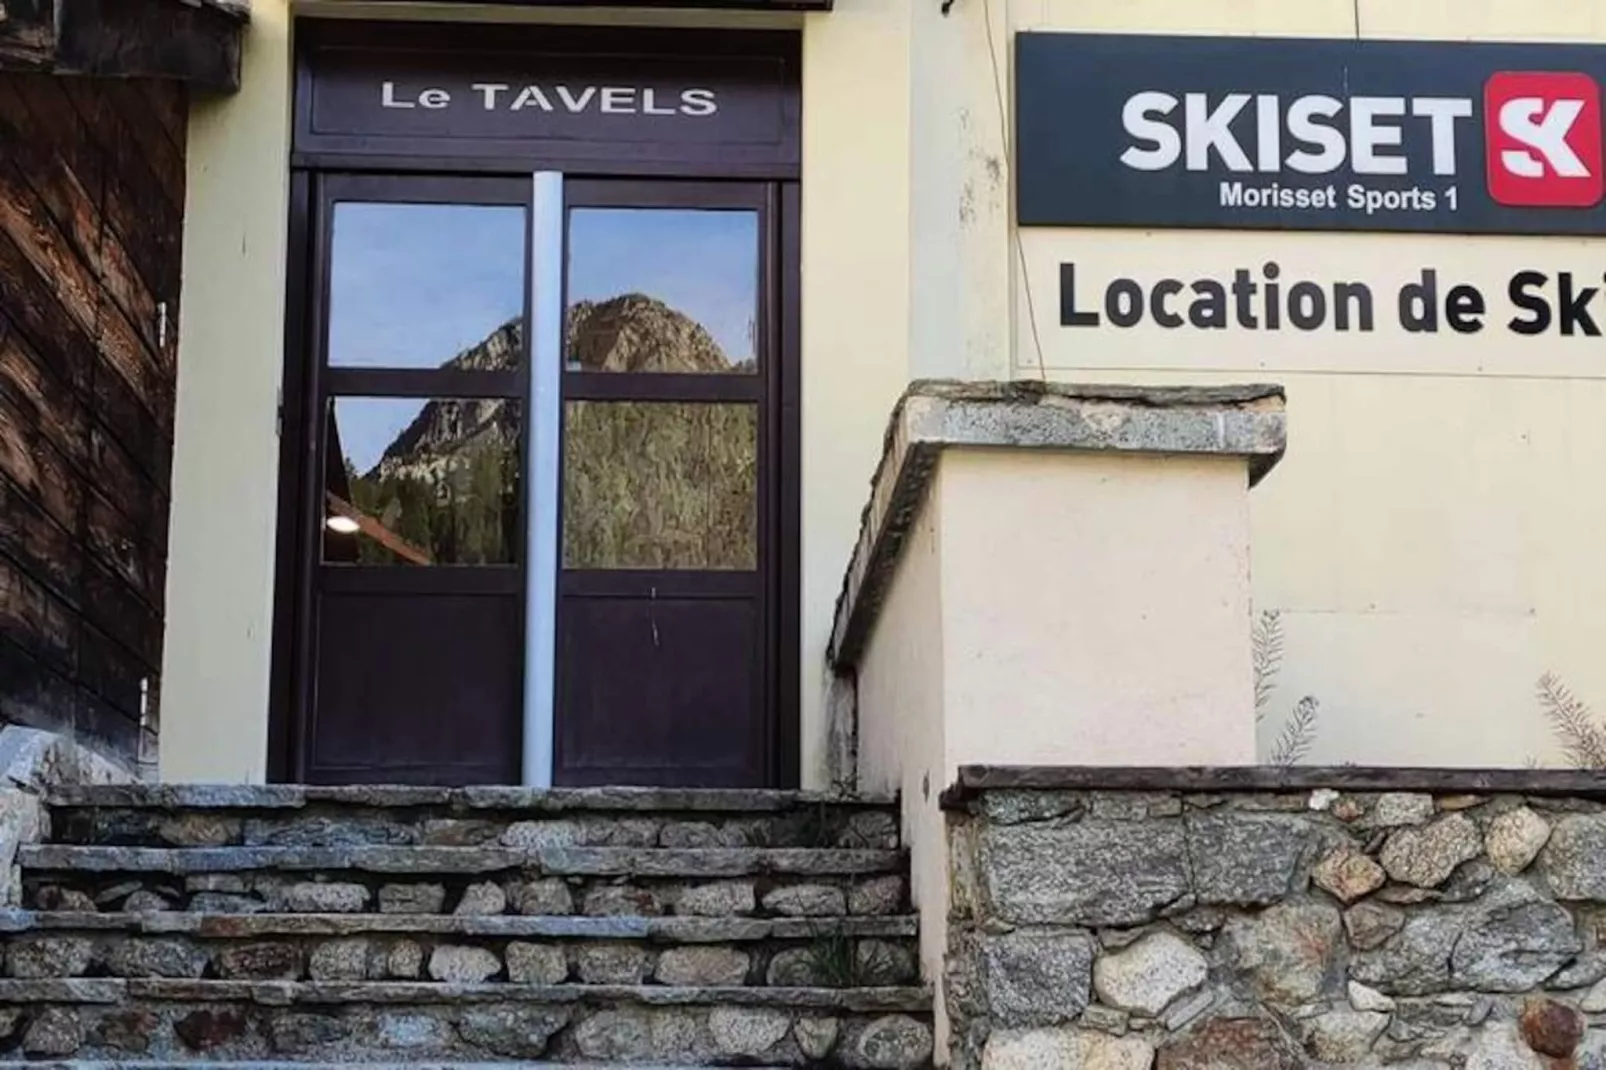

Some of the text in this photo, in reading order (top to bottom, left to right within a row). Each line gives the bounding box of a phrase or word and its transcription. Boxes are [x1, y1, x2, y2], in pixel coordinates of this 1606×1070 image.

[381, 81, 718, 116] Le TAVELS
[1119, 91, 1473, 176] SKISET
[1219, 180, 1458, 215] Morisset Sports 1
[1059, 261, 1606, 337] Location de Sk
